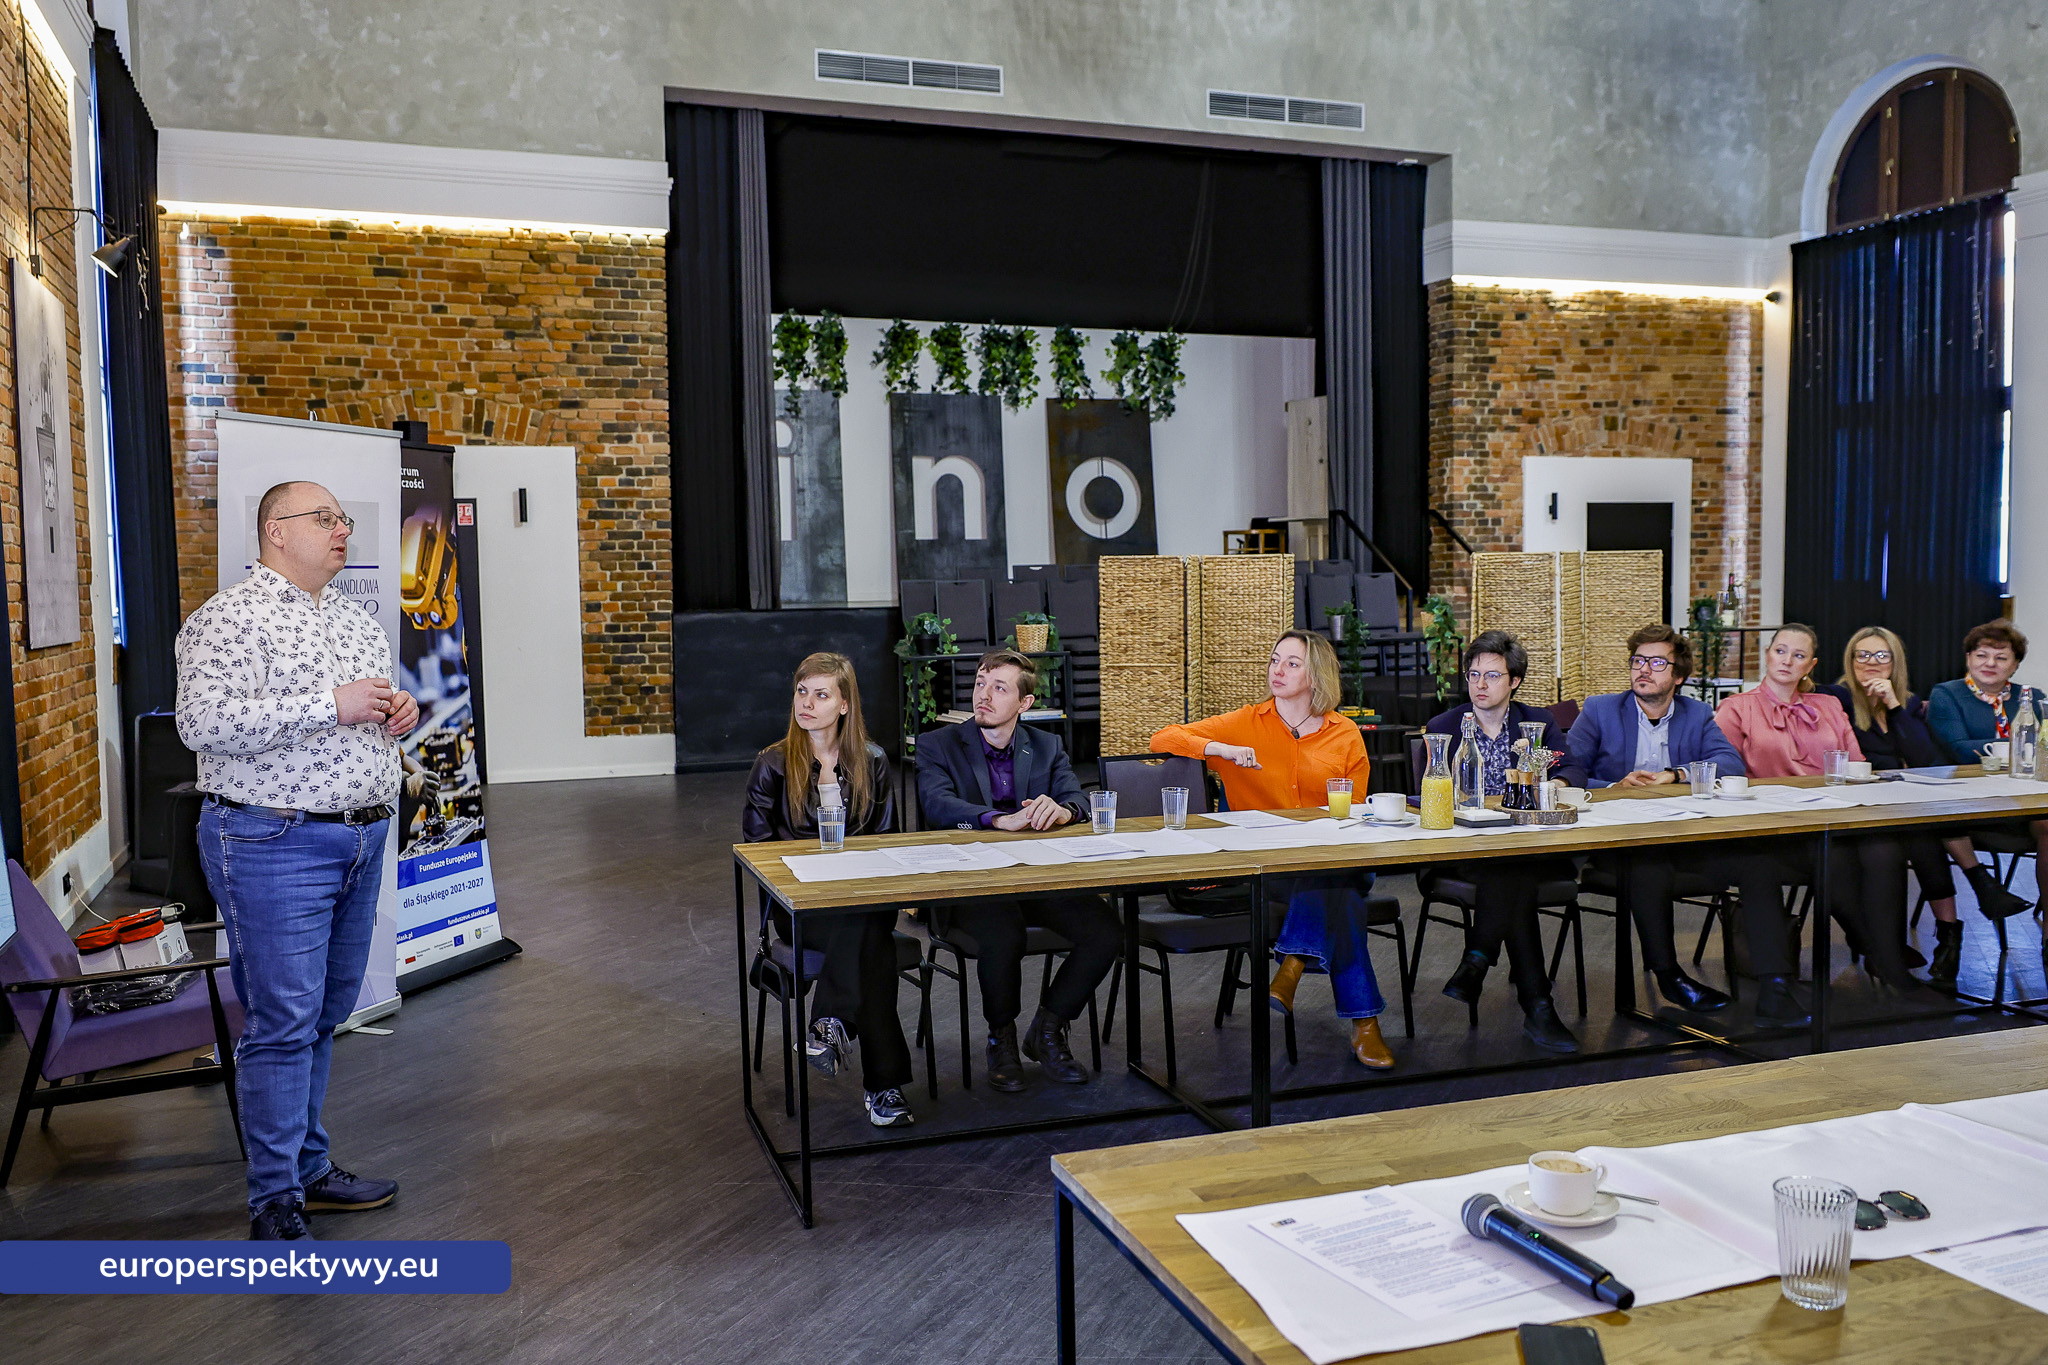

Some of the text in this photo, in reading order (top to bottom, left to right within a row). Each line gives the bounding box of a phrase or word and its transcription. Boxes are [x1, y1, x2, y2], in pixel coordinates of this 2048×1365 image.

[419, 851, 478, 872] Fundusze Europejskie
[403, 877, 484, 908] dla Śląskiego 2021-2027
